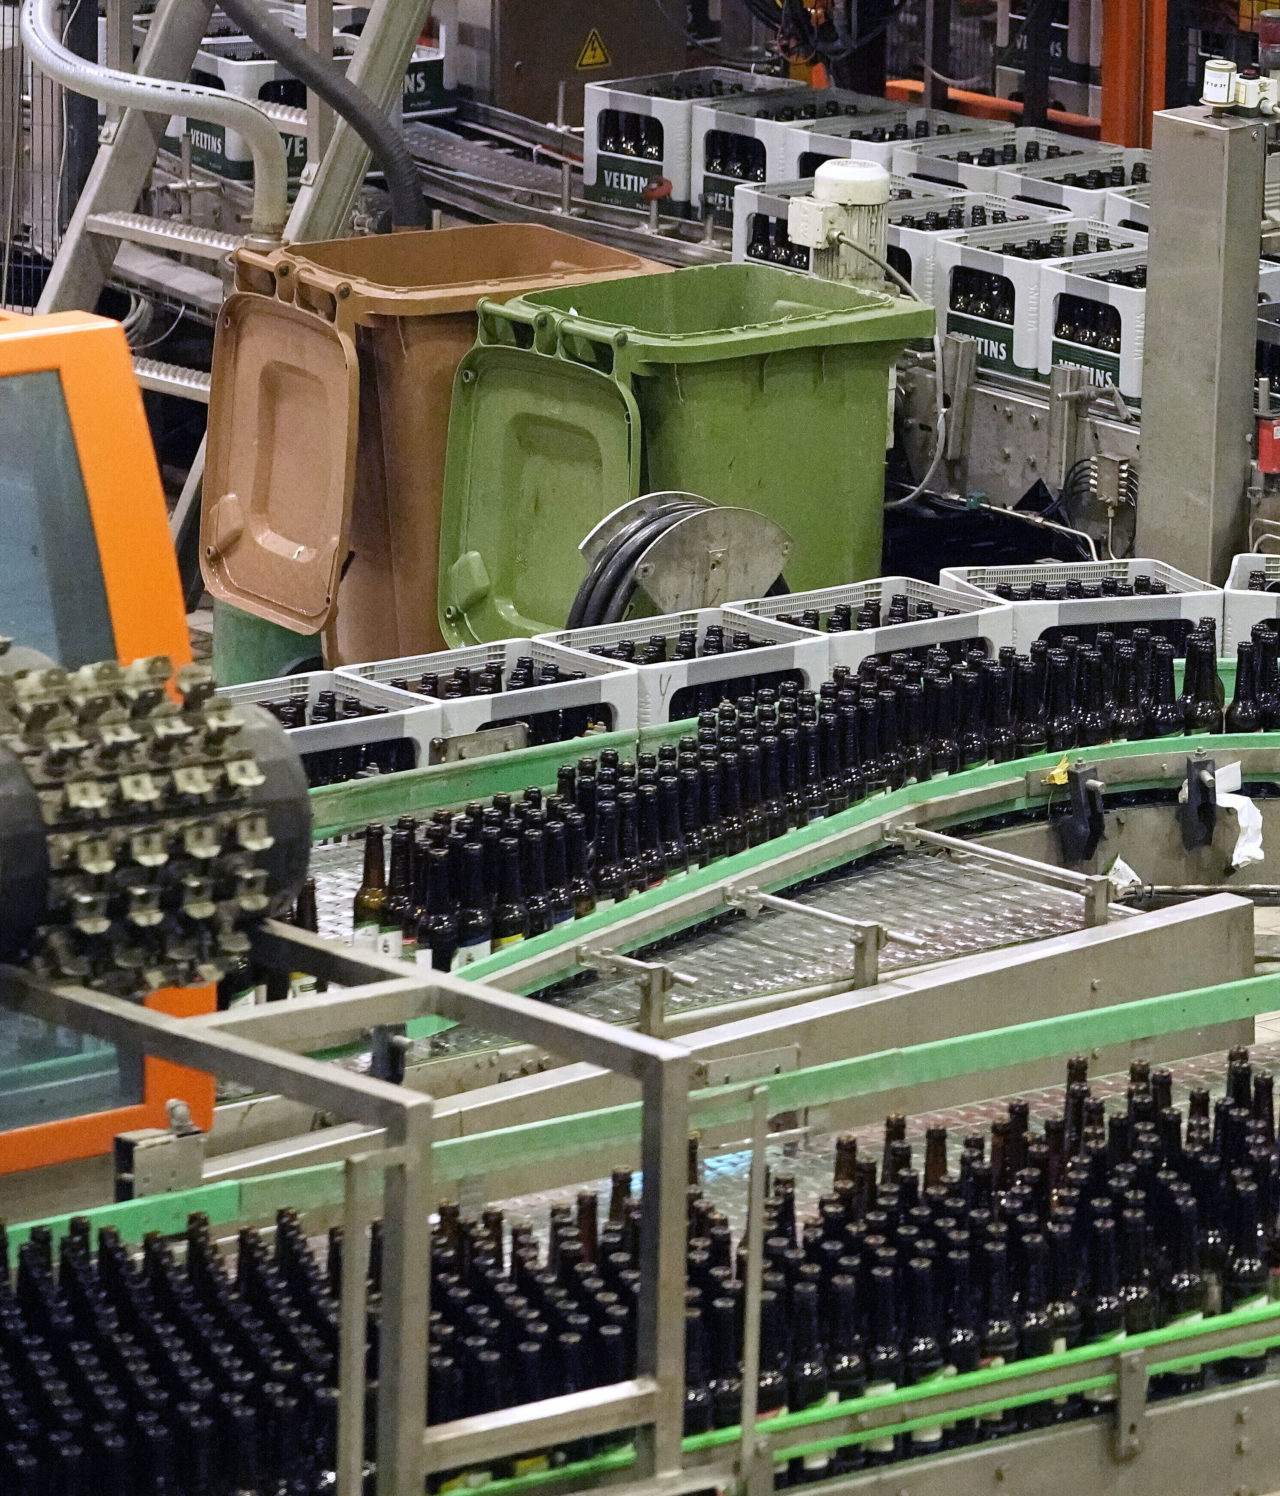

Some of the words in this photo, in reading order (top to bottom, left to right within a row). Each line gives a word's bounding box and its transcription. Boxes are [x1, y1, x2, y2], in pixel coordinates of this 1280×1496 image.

[190, 128, 222, 154] VELTINS
[604, 169, 649, 193] VELTIN
[975, 336, 1008, 361] TINS
